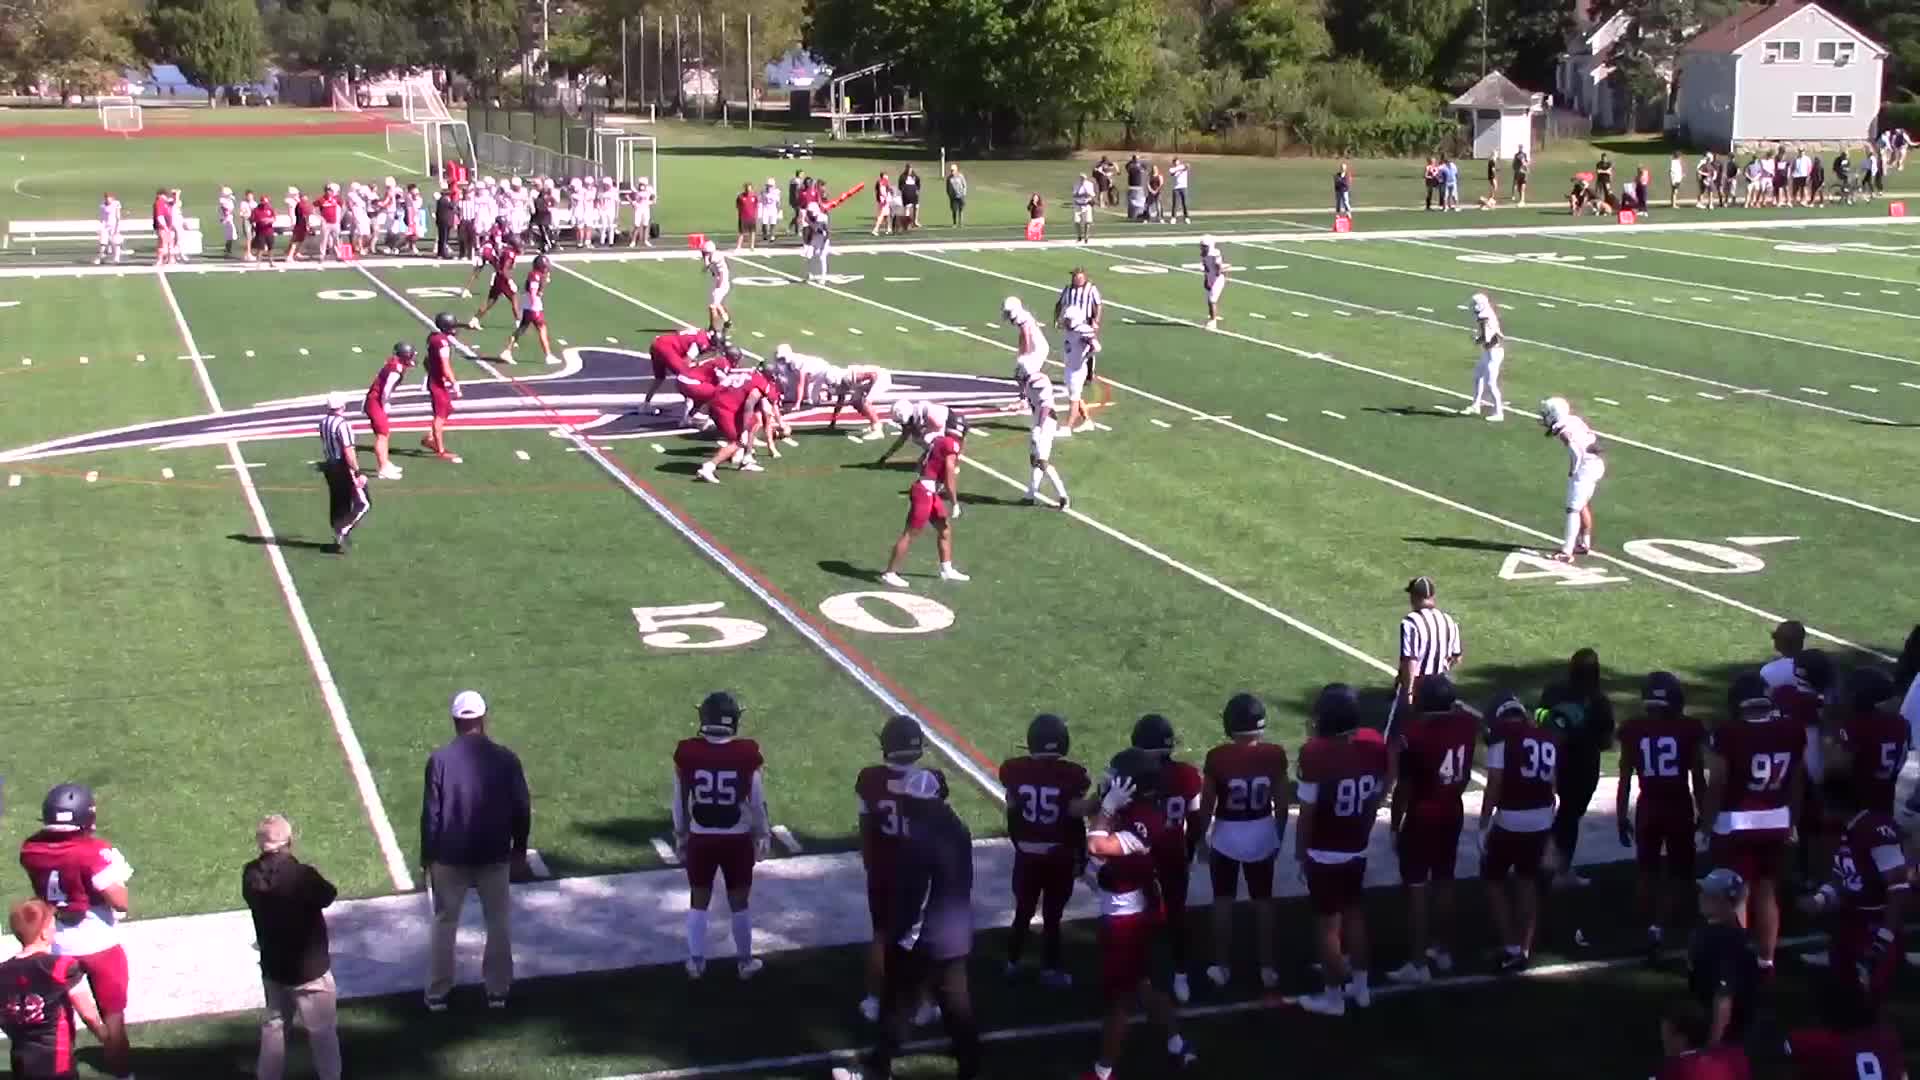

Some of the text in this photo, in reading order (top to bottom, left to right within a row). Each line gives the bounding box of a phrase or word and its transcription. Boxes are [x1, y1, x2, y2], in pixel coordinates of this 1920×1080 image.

[1438, 743, 1466, 785] 41
[1520, 738, 1557, 782] 39
[1639, 736, 1681, 777] 12
[1747, 751, 1792, 792] 97
[693, 769, 738, 806] 25
[1017, 783, 1061, 825] 35
[1226, 775, 1272, 813] 20
[46, 869, 69, 908] 4
